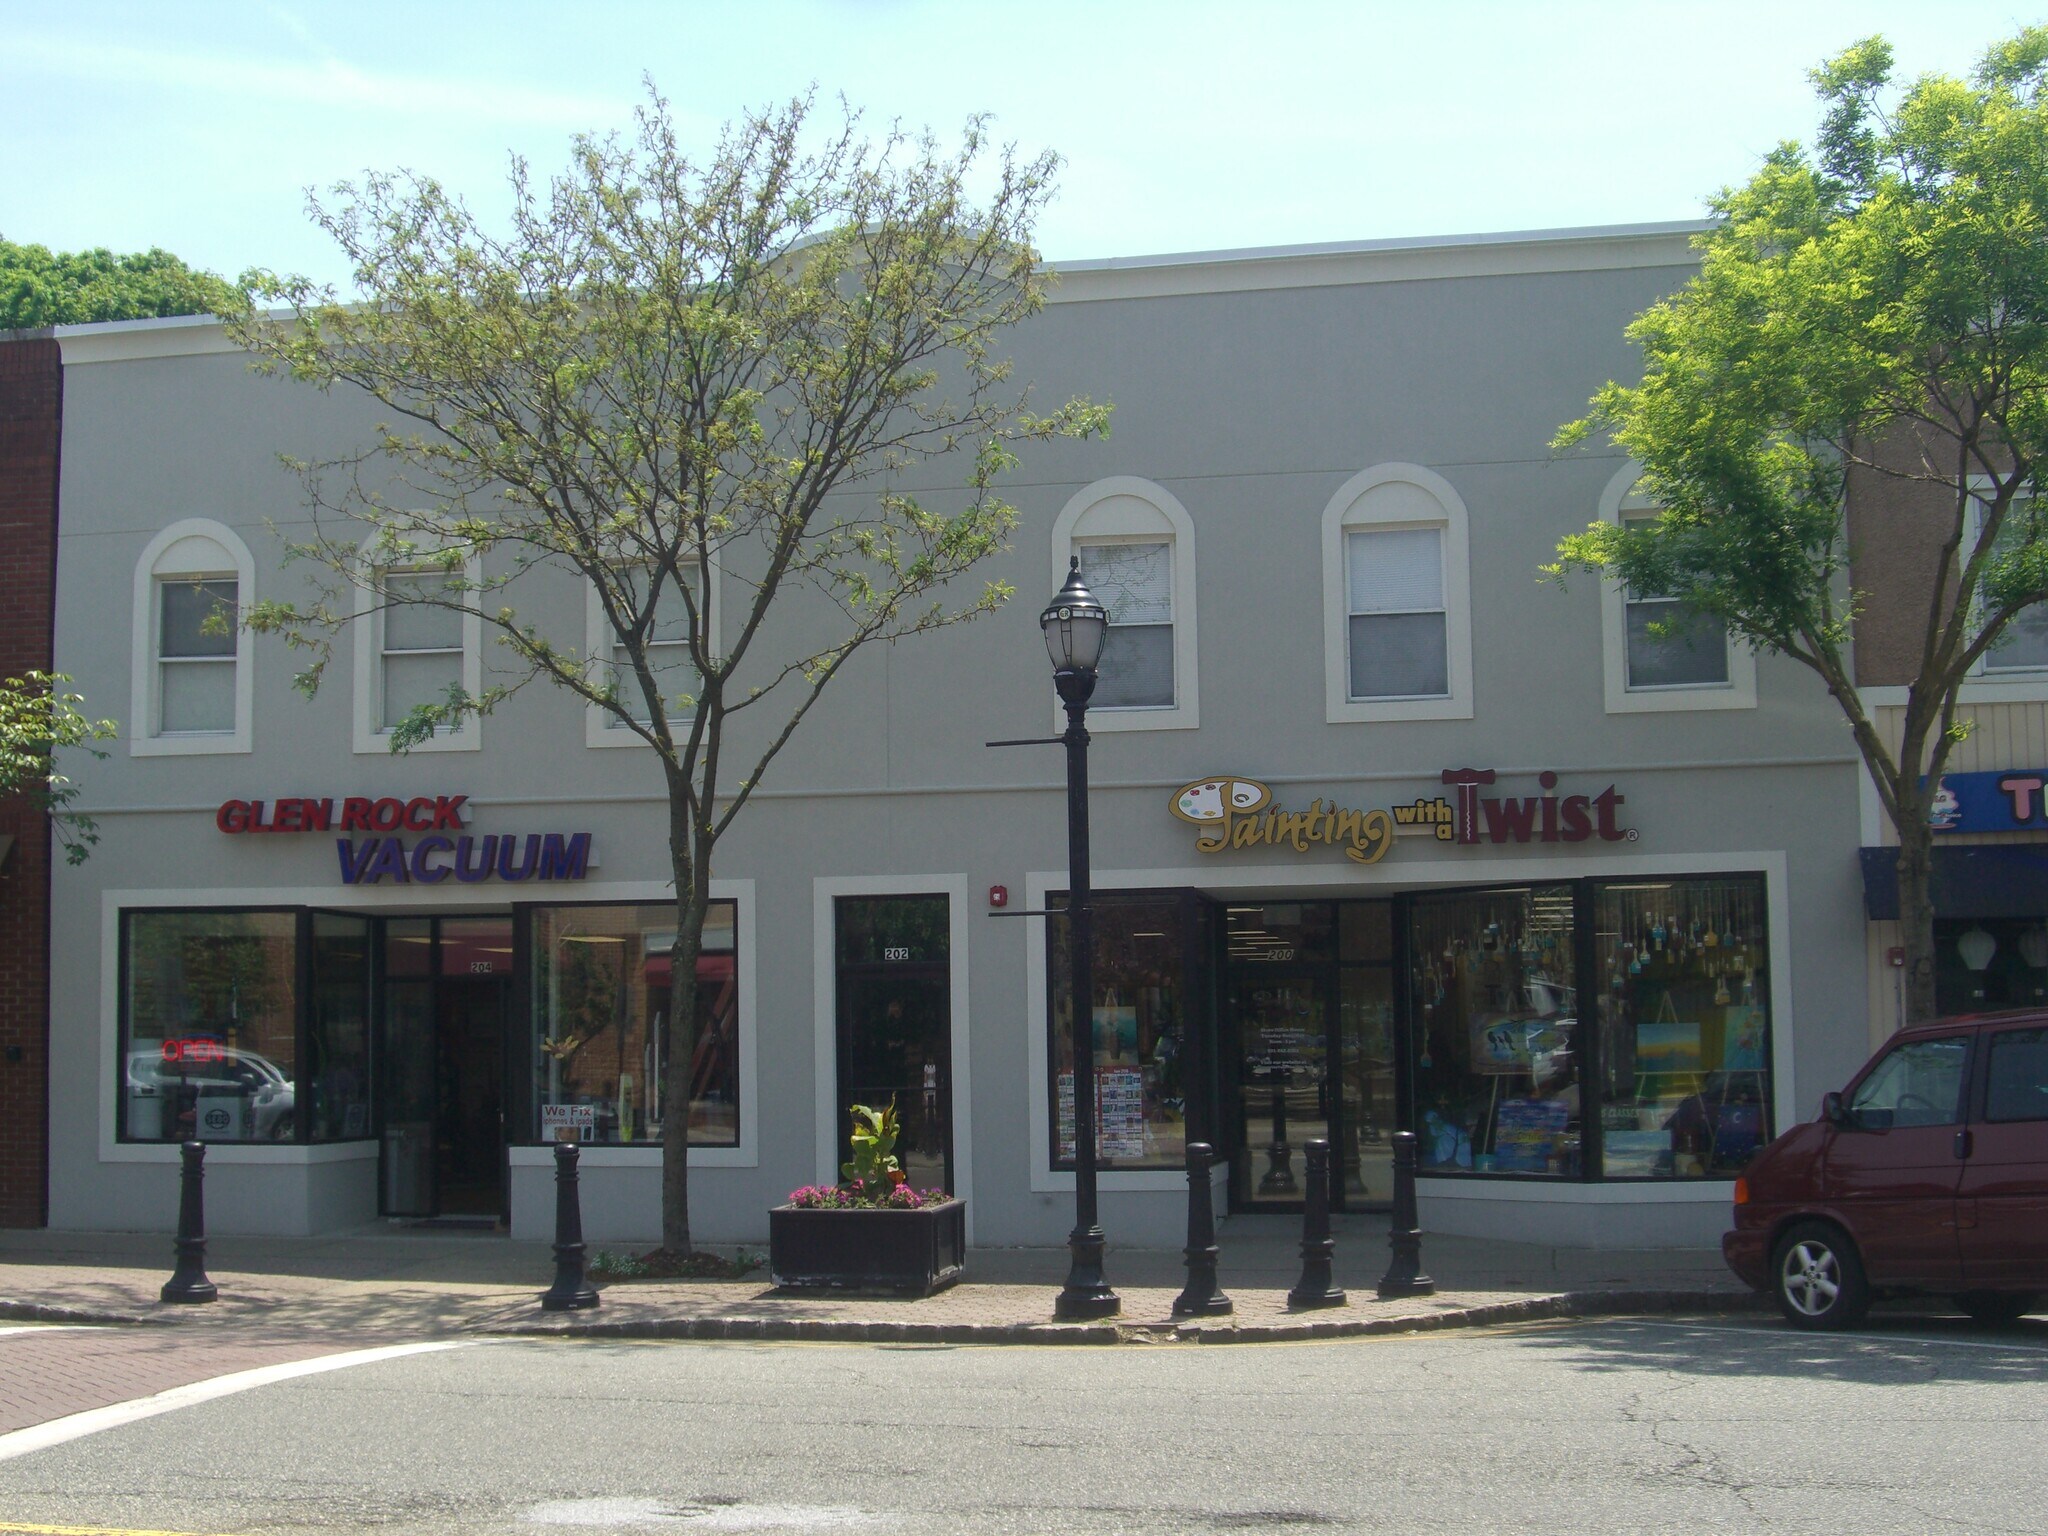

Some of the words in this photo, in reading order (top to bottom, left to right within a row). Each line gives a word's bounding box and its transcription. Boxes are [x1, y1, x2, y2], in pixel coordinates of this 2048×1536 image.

[1394, 798, 1453, 826] with
[1441, 767, 1626, 845] Twist
[2001, 778, 2048, 821] T
[216, 796, 335, 834] GLEN
[339, 794, 471, 832] ROCK
[1168, 774, 1394, 865] Painting
[1435, 822, 1453, 841] a
[335, 832, 593, 886] VACUUM
[886, 949, 908, 959] 202
[1268, 949, 1293, 960] 200
[471, 962, 491, 973] 204
[161, 1039, 225, 1063] OPEN
[545, 1105, 566, 1116] We
[570, 1105, 592, 1116] Fix
